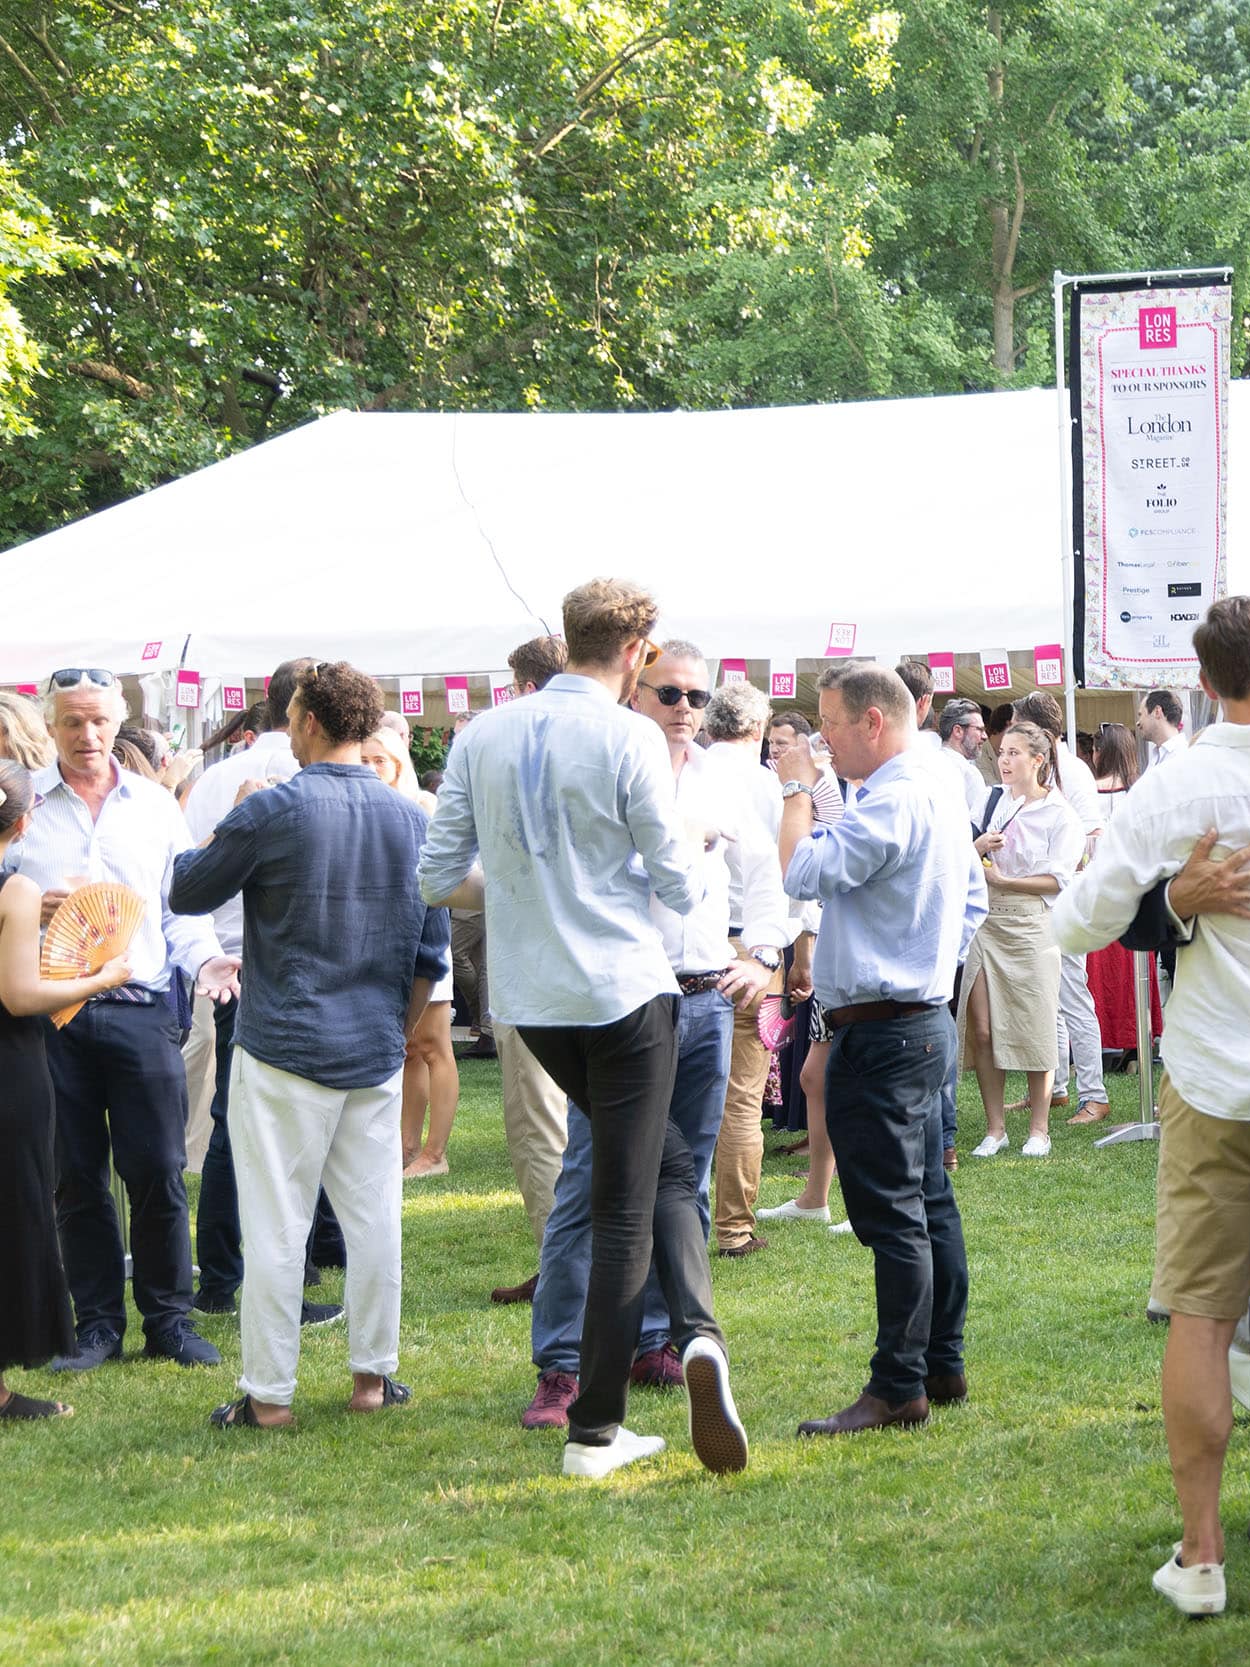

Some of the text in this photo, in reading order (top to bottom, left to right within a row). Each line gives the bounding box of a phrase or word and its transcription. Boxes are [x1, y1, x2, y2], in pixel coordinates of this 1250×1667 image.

[1145, 313, 1171, 329] LON
[1145, 328, 1171, 343] RES
[1111, 364, 1207, 379] SPECIAL THANKS
[1112, 379, 1207, 393] TO OUR SPONSORS
[1127, 412, 1193, 435] London
[1146, 498, 1177, 508] FOLIO
[1122, 586, 1150, 595] Prestige
[987, 667, 1005, 677] LON
[1040, 663, 1057, 673] LON
[935, 671, 951, 680] LON
[1040, 672, 1057, 681] RES
[775, 676, 791, 685] LON
[935, 679, 951, 689] RES
[989, 676, 1006, 685] RES
[775, 684, 791, 693] RES
[226, 690, 241, 698] LON
[404, 694, 419, 702] LON
[227, 698, 242, 706] RES
[405, 702, 419, 710] RES
